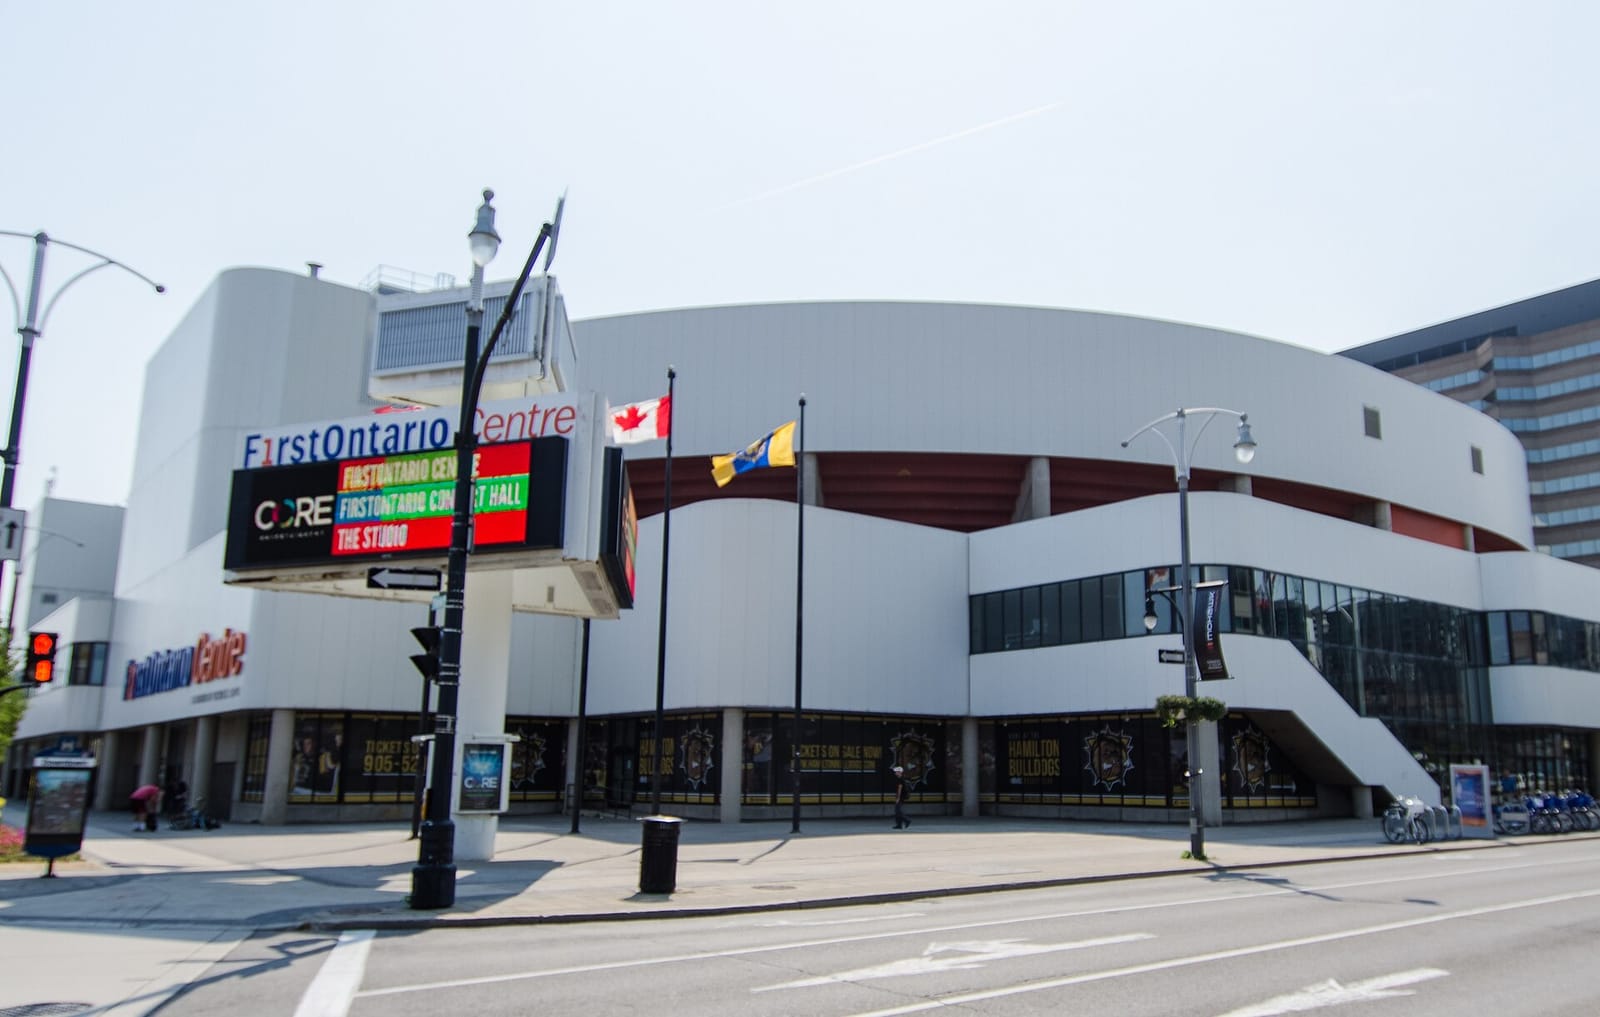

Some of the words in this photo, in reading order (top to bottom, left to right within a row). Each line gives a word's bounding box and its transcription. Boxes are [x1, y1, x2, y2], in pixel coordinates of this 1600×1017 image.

[343, 457, 429, 490] FIRSTONTARIO
[431, 452, 481, 482] CENE
[339, 490, 426, 519] FIRSTONTARIO
[429, 484, 486, 512] CONT
[489, 482, 521, 507] HALL
[337, 527, 361, 551] THE
[362, 523, 408, 550] STUDIO
[1008, 739, 1060, 758] HAMILTON
[1009, 758, 1061, 777] BULLDOGS
